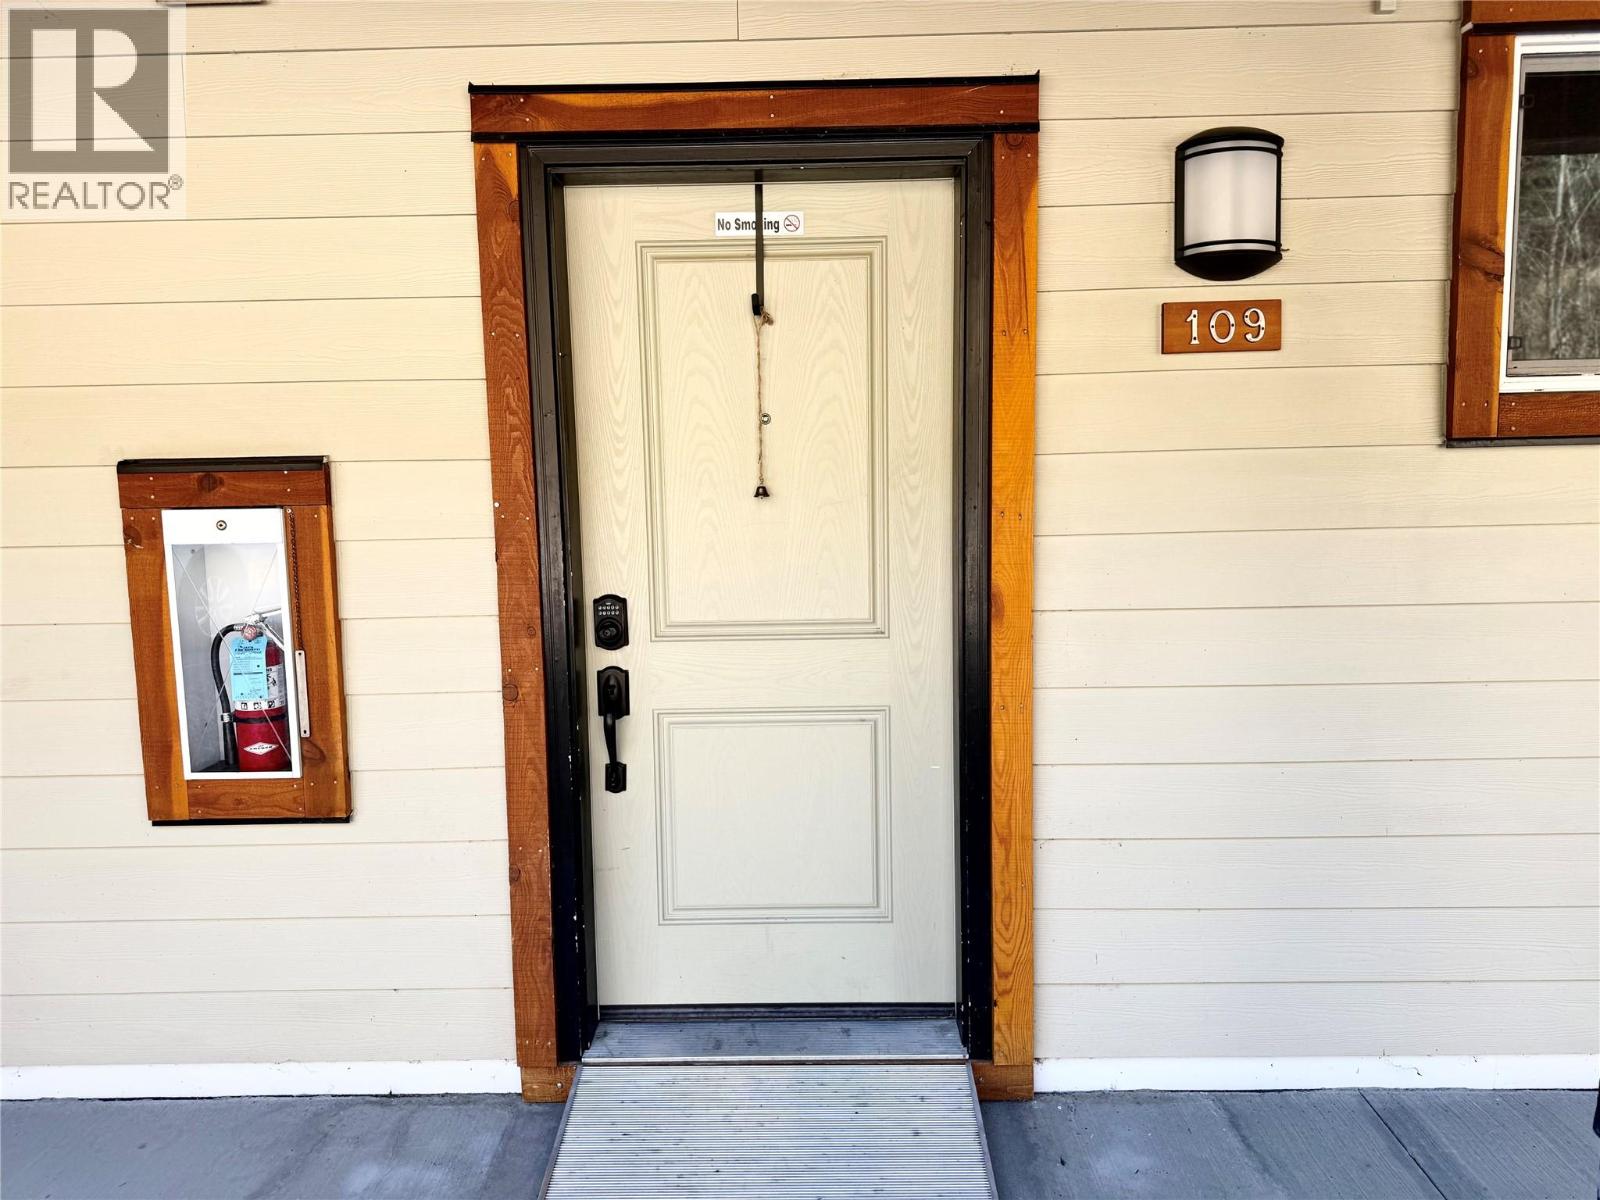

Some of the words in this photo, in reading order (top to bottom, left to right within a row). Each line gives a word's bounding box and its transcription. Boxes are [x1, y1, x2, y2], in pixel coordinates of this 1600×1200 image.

[717, 218, 731, 231] No
[734, 217, 780, 233] Smoing
[1185, 307, 1266, 345] 109
